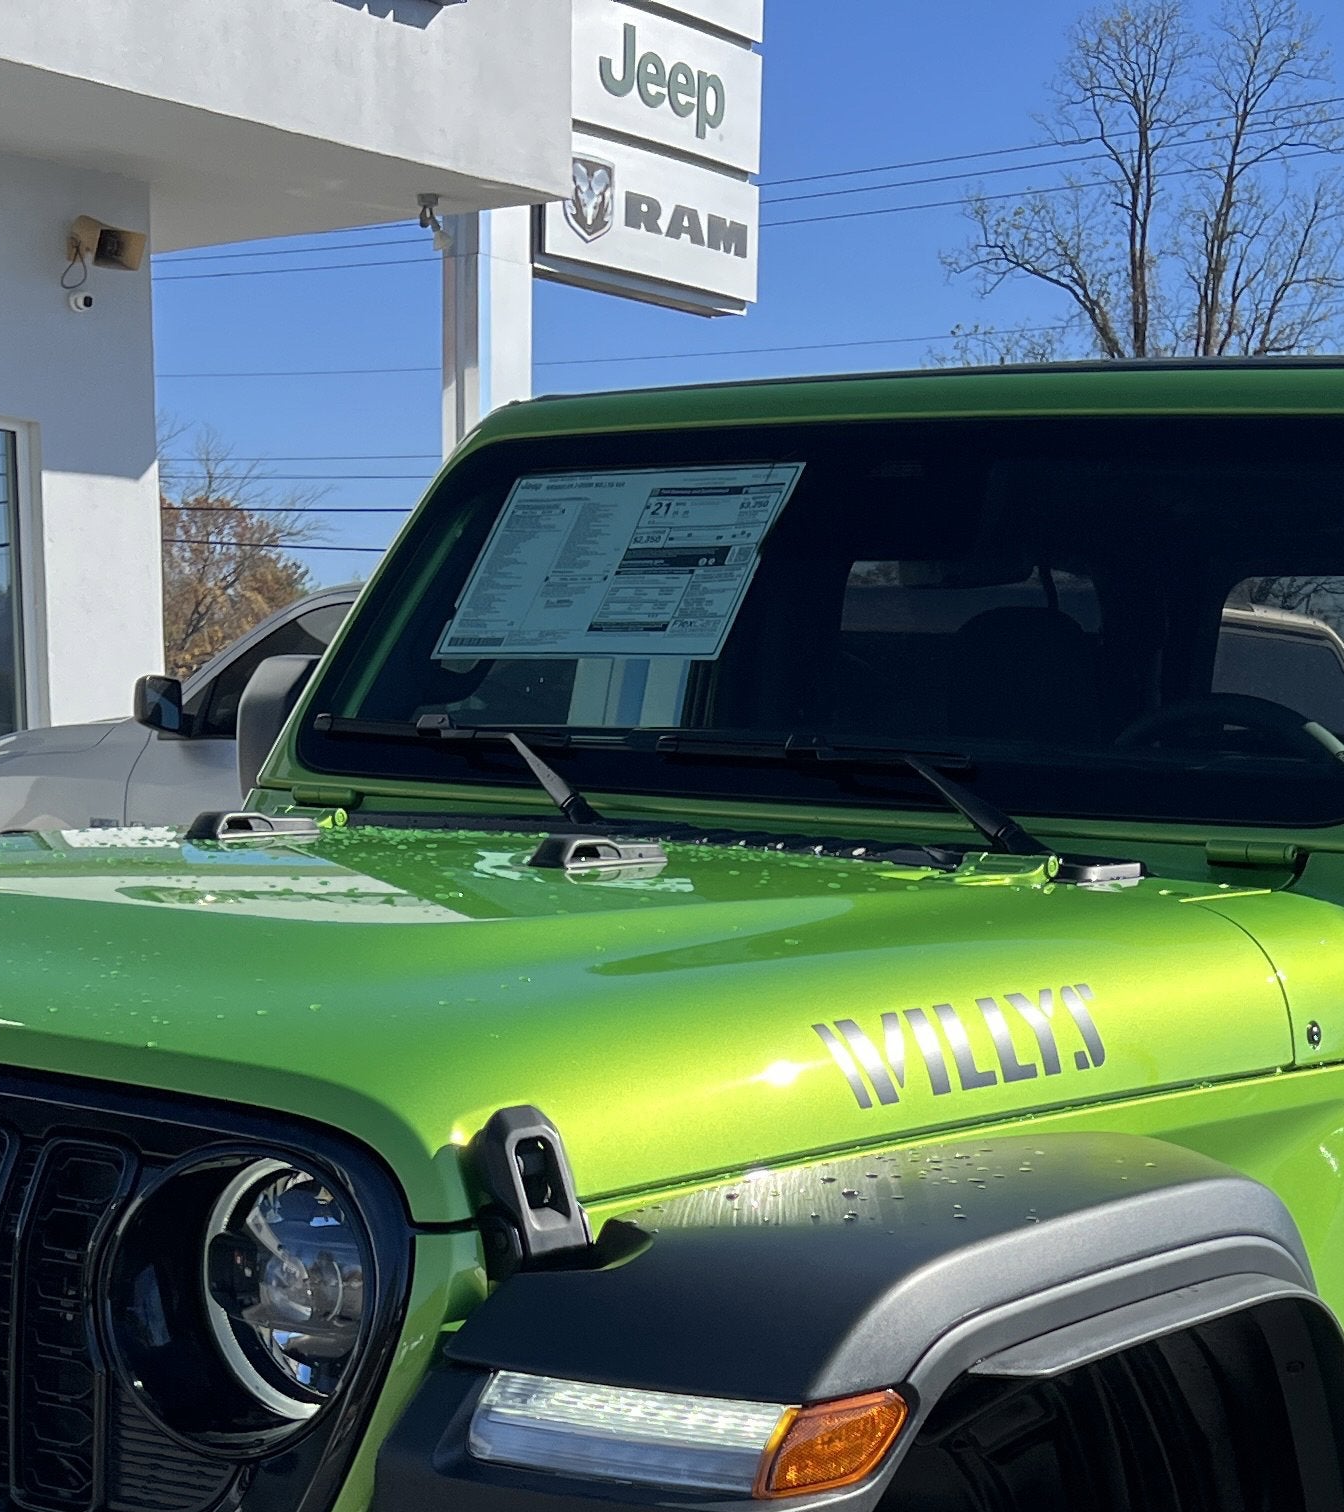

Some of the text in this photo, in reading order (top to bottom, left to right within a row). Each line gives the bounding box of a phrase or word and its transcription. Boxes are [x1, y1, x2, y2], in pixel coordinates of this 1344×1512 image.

[599, 22, 726, 139] Jeep
[624, 190, 748, 259] RAM
[811, 983, 1106, 1110] WILLYS
